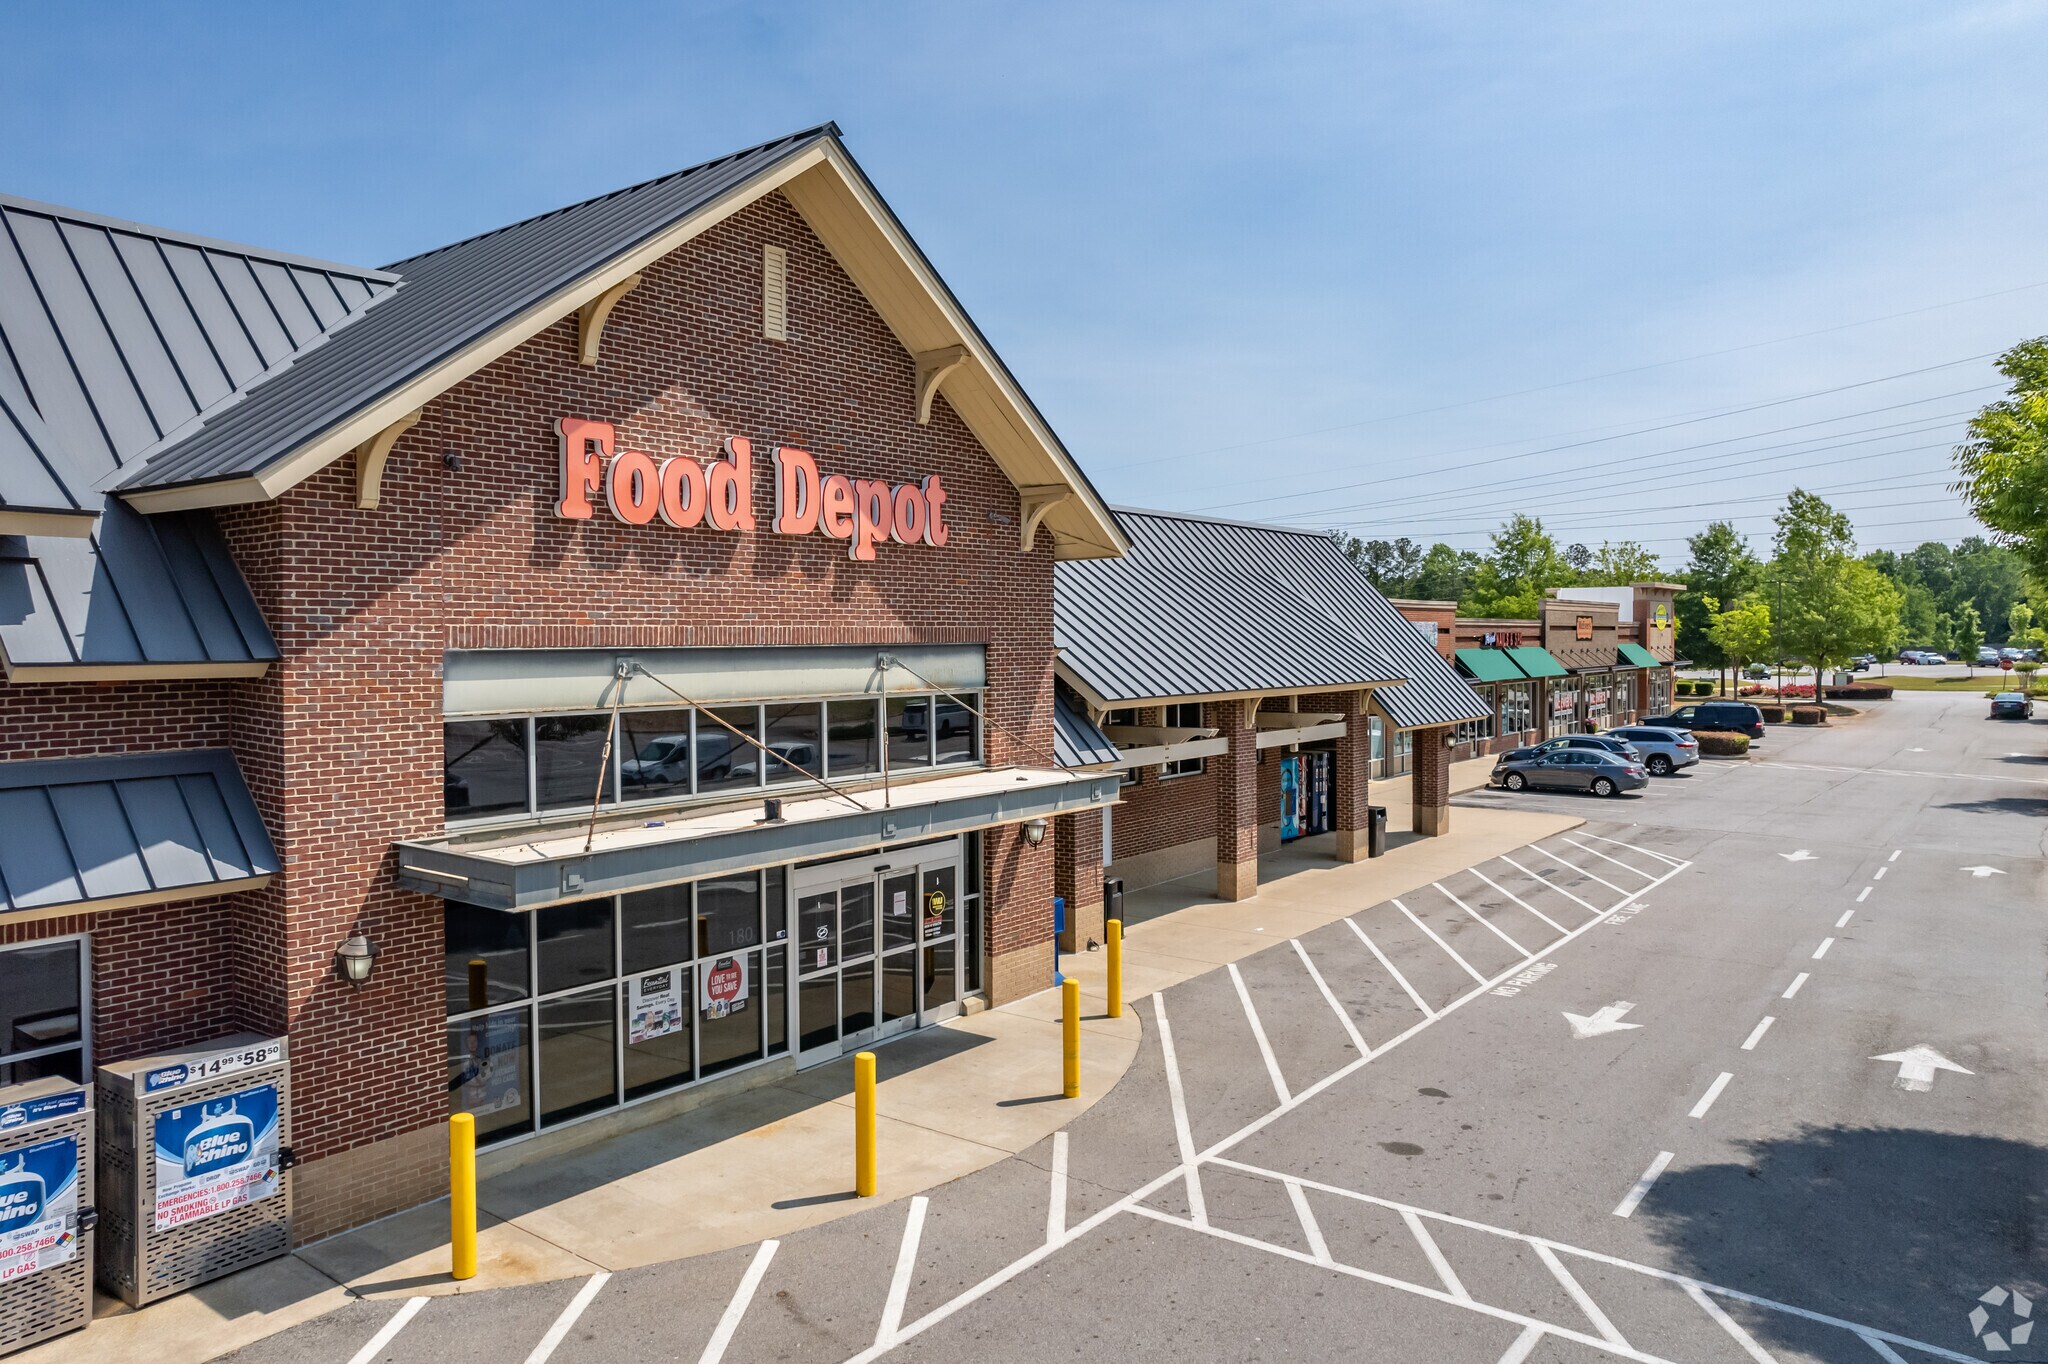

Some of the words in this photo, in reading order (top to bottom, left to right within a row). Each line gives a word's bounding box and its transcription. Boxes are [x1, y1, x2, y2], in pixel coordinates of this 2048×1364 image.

[554, 417, 756, 531] Food
[771, 446, 949, 561] Depot
[730, 927, 753, 944] 180
[643, 975, 670, 988] Essential
[644, 983, 668, 992] EVERYDAY
[711, 974, 726, 986] LOVE
[712, 984, 723, 995] YOU
[724, 980, 738, 992] SAVE
[1488, 986, 1521, 997] NO
[1505, 962, 1558, 987] PARKING
[161, 1069, 181, 1078] Blue
[200, 1131, 240, 1151] Blue
[195, 1143, 247, 1166] Rhino
[0, 1191, 29, 1207] ue
[0, 1204, 37, 1222] ino
[158, 1210, 169, 1220] NO
[170, 1198, 208, 1216] SMOKING
[170, 1203, 219, 1224] FLAMMABLE
[222, 1200, 231, 1209] LP
[233, 1194, 248, 1205] GAS
[20, 1228, 39, 1238] SWAP
[3, 1268, 14, 1278] LP
[17, 1261, 36, 1274] GAS
